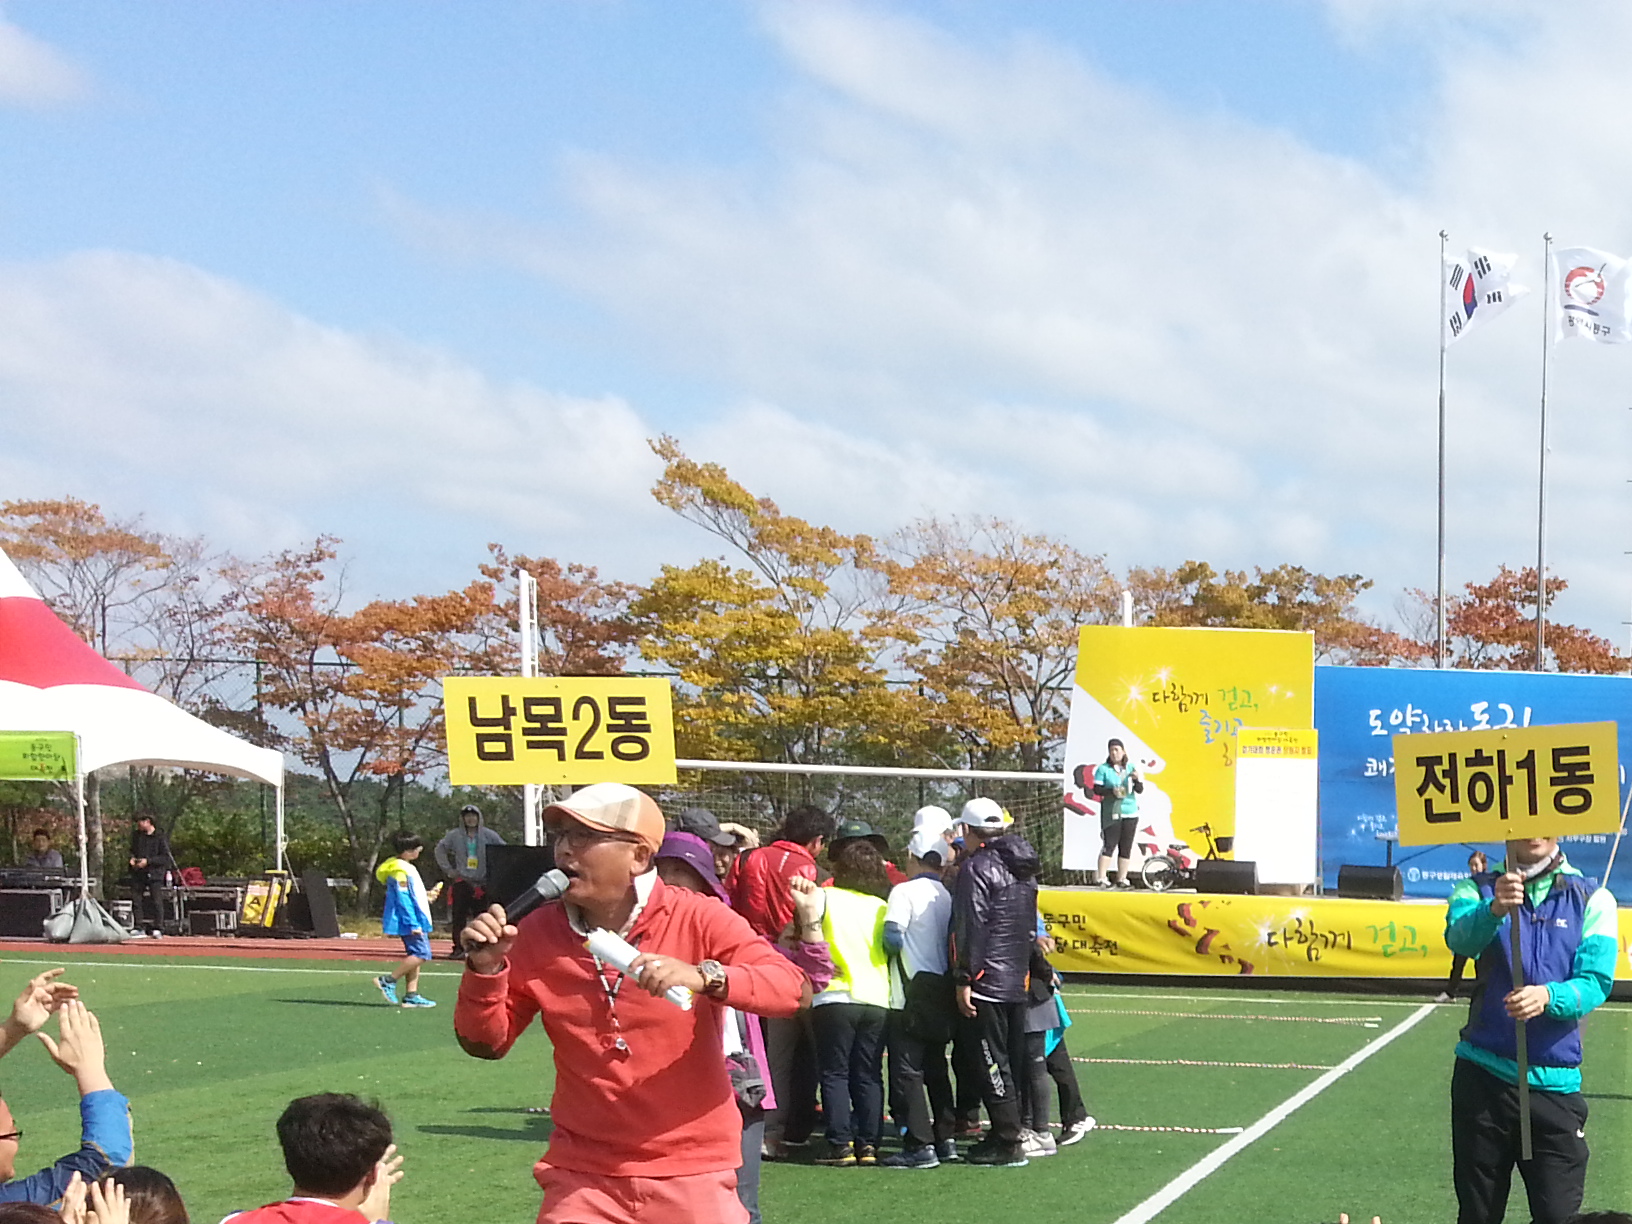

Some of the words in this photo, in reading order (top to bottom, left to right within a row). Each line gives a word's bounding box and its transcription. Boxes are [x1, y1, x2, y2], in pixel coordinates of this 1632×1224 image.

[1152, 682, 1209, 713] 다함께
[1217, 686, 1259, 712] 걷고,
[468, 695, 652, 762] 남목2동
[1415, 745, 1595, 824] 전하1동
[1267, 917, 1352, 962] 다함께
[1366, 921, 1428, 958] 걷고,
